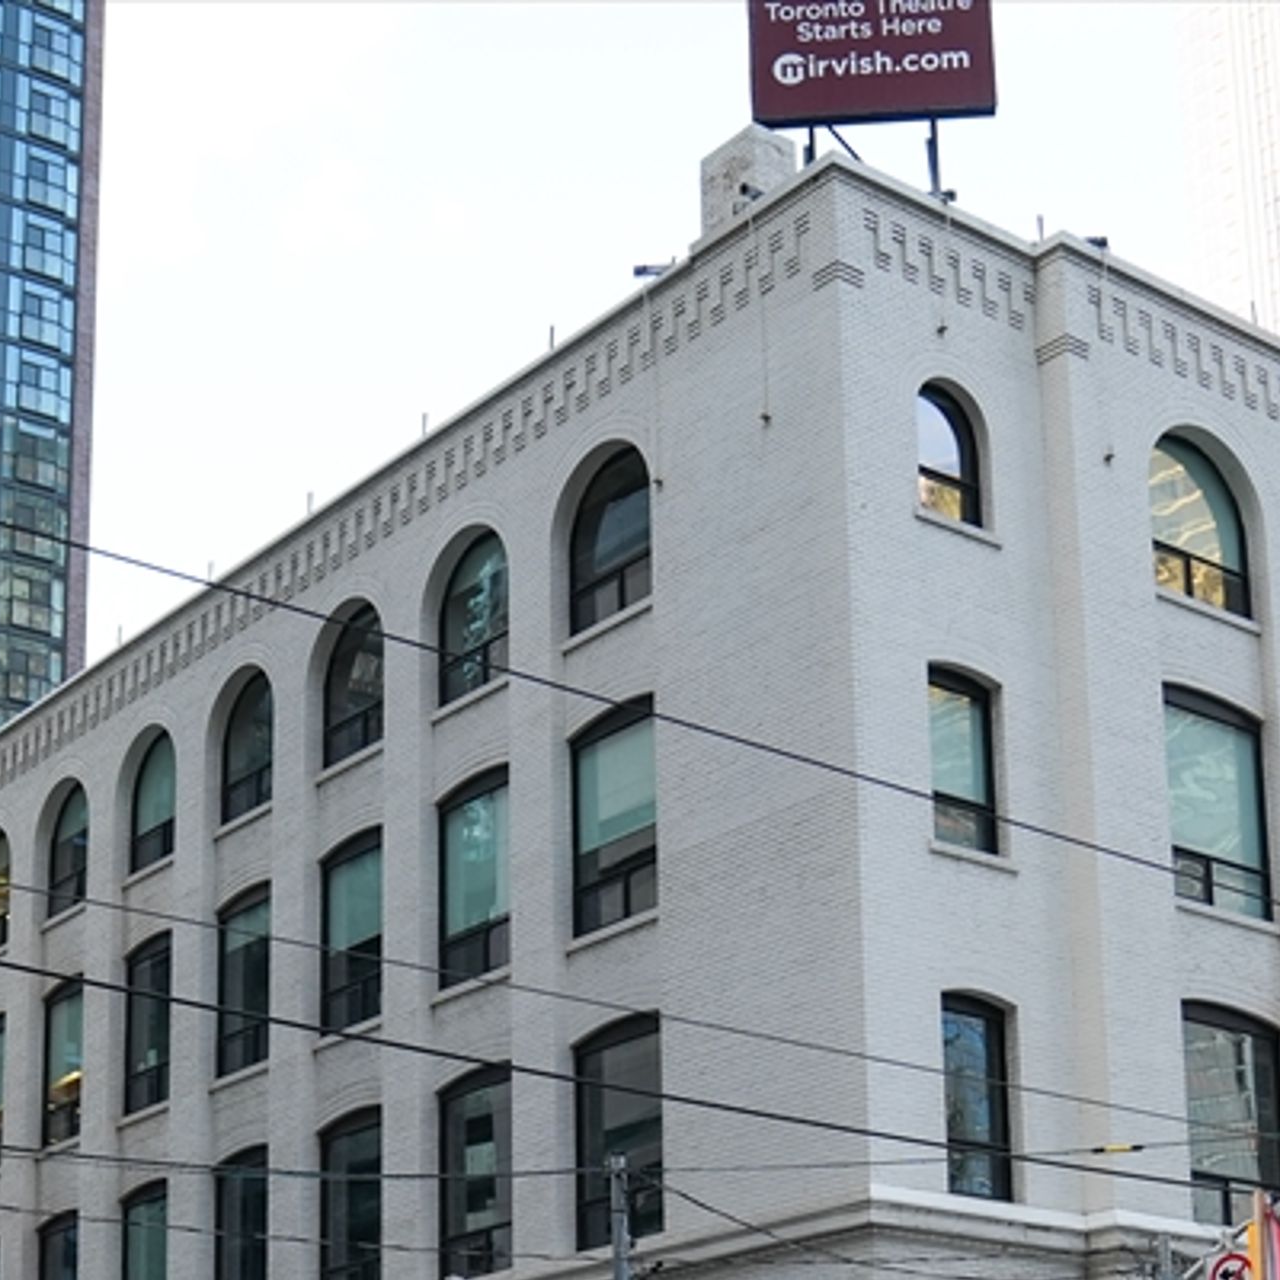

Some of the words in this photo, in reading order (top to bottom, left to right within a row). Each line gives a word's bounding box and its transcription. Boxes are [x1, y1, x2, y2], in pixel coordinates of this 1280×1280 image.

[764, 1, 864, 22] Toronto
[796, 20, 872, 43] Starts
[881, 17, 942, 37] Here
